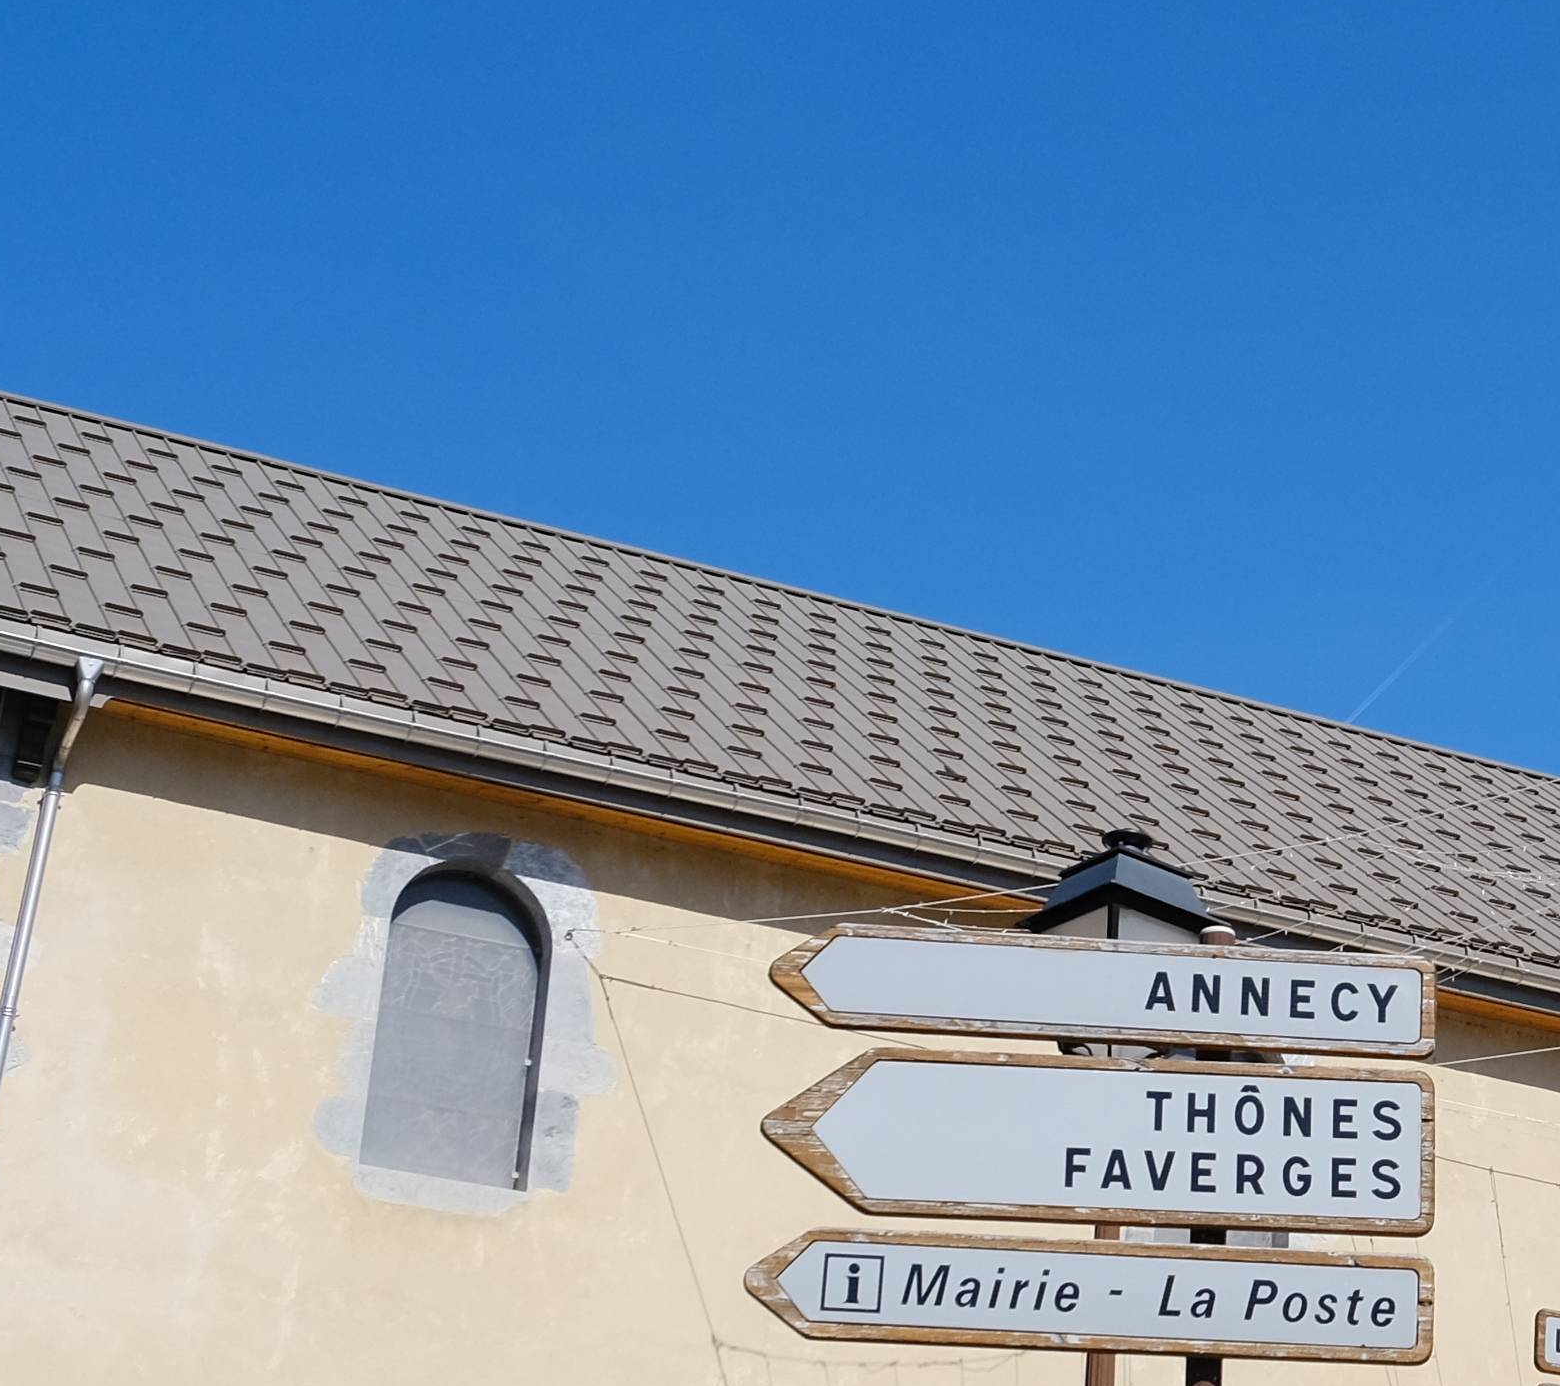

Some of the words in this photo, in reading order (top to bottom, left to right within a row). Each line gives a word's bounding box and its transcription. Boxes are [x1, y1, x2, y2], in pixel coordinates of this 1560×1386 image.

[1145, 971, 1398, 1023] ANNECY
[1146, 1084, 1402, 1141] THÔNES
[1064, 1147, 1401, 1200] FAVERGES
[901, 1263, 1080, 1313] Mairie
[1158, 1275, 1216, 1319] La
[1244, 1279, 1396, 1328] Poste
